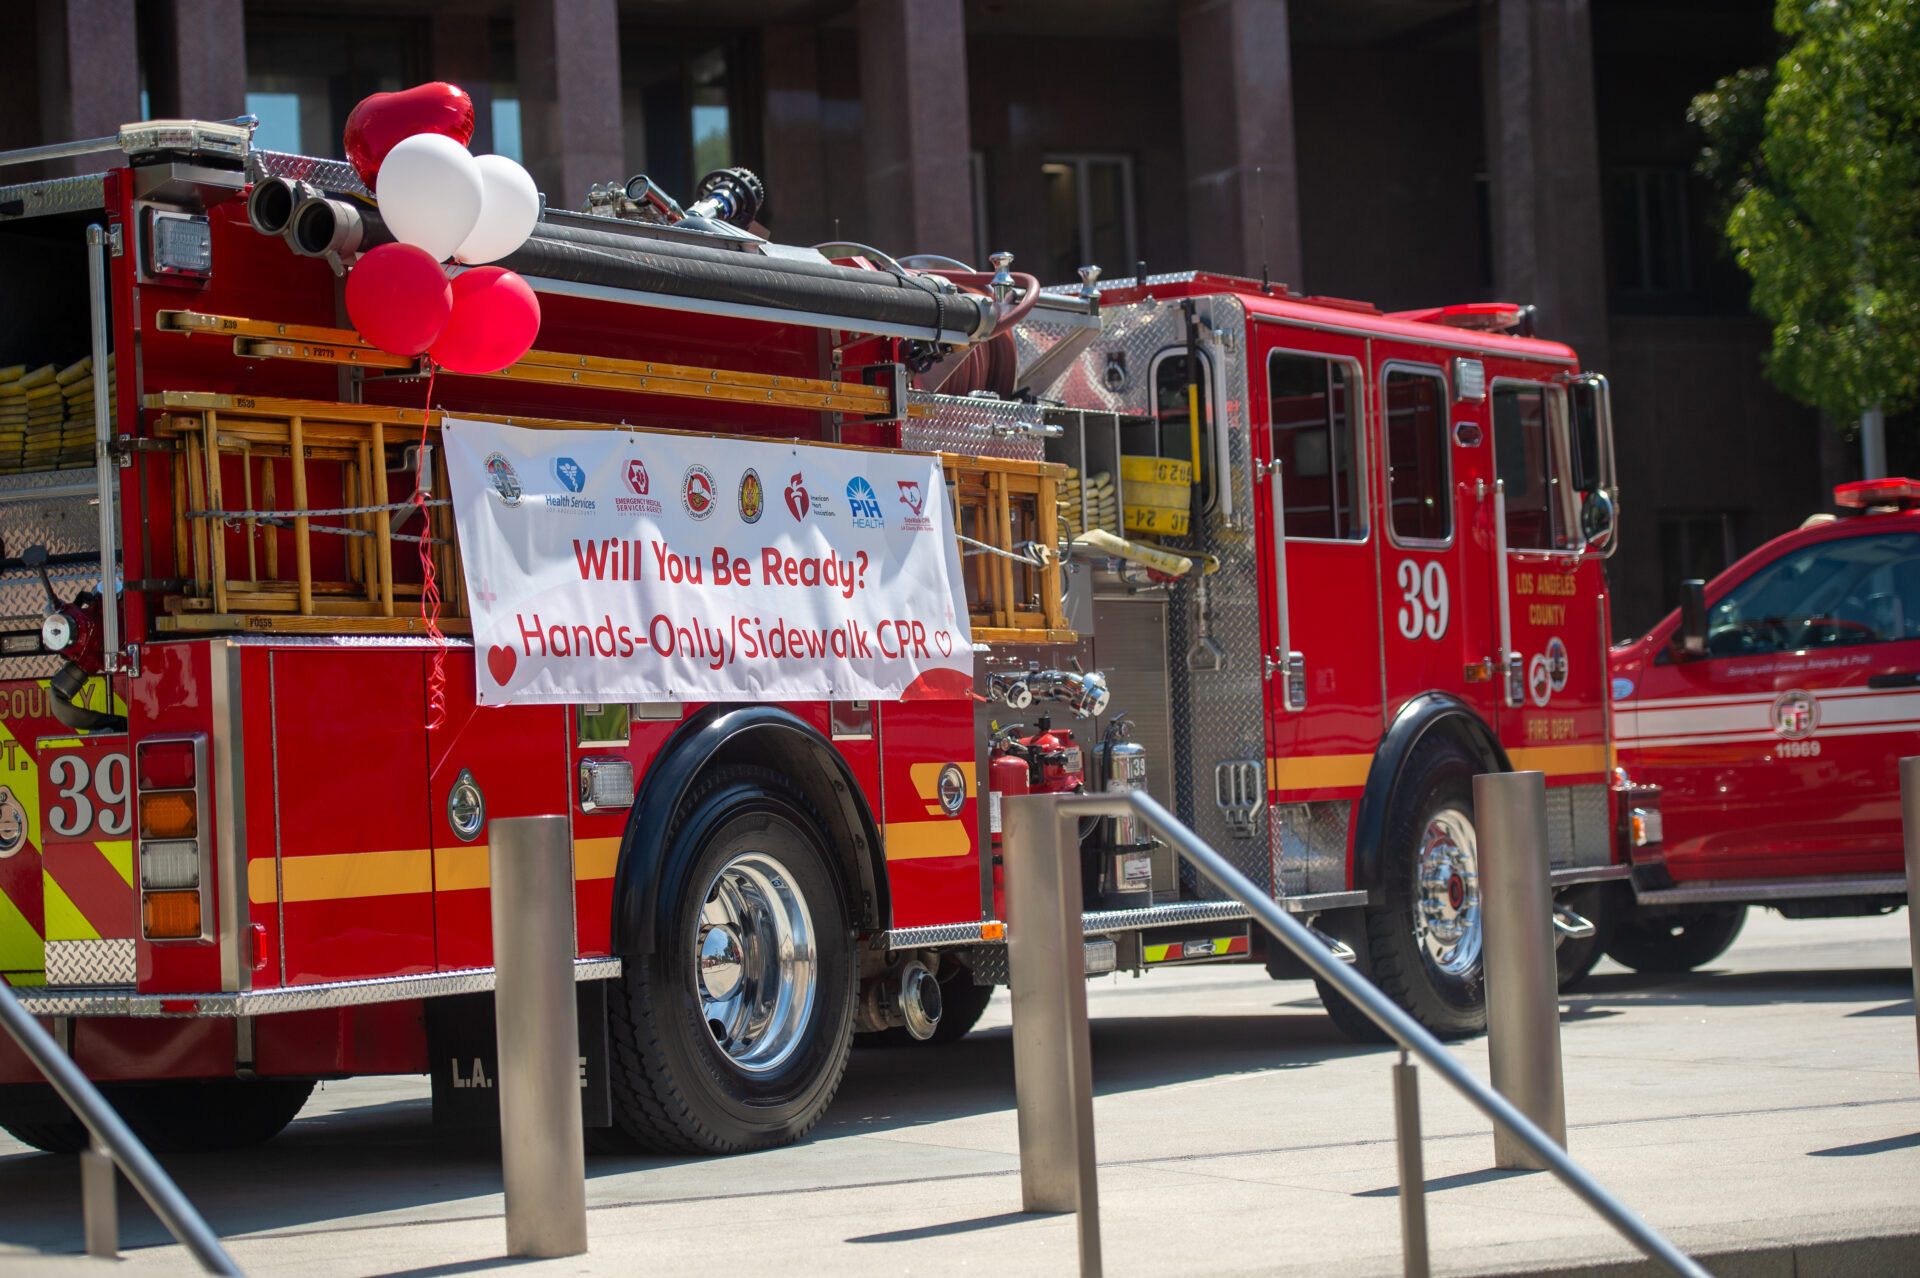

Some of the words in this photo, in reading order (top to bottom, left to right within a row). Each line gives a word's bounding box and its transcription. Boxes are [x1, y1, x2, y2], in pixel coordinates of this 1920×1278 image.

[223, 319, 238, 330] E39
[545, 494, 570, 507] Health
[570, 496, 596, 509] Services
[646, 506, 662, 514] AGENCY
[690, 501, 715, 518] DEPARTMENT
[849, 500, 883, 518] PIH
[852, 518, 885, 529] HEALTH
[572, 537, 642, 581] Will
[651, 540, 703, 585] You
[712, 546, 751, 586] Be
[761, 547, 869, 599] Ready?
[1516, 573, 1534, 594] LOS
[1537, 574, 1577, 596] ANGELES
[1397, 558, 1449, 641] 39
[1528, 604, 1566, 626] COUNTY
[517, 614, 872, 671] Hands-Only/Sidewalk
[877, 619, 931, 660] CPR
[0, 684, 95, 720] COUY
[1527, 719, 1549, 741] FIRE
[1551, 718, 1579, 740] DEPT.
[1774, 740, 1821, 759] 11969
[1132, 757, 1146, 776] 39
[49, 752, 132, 837] 39
[451, 1057, 492, 1089] L.A.
